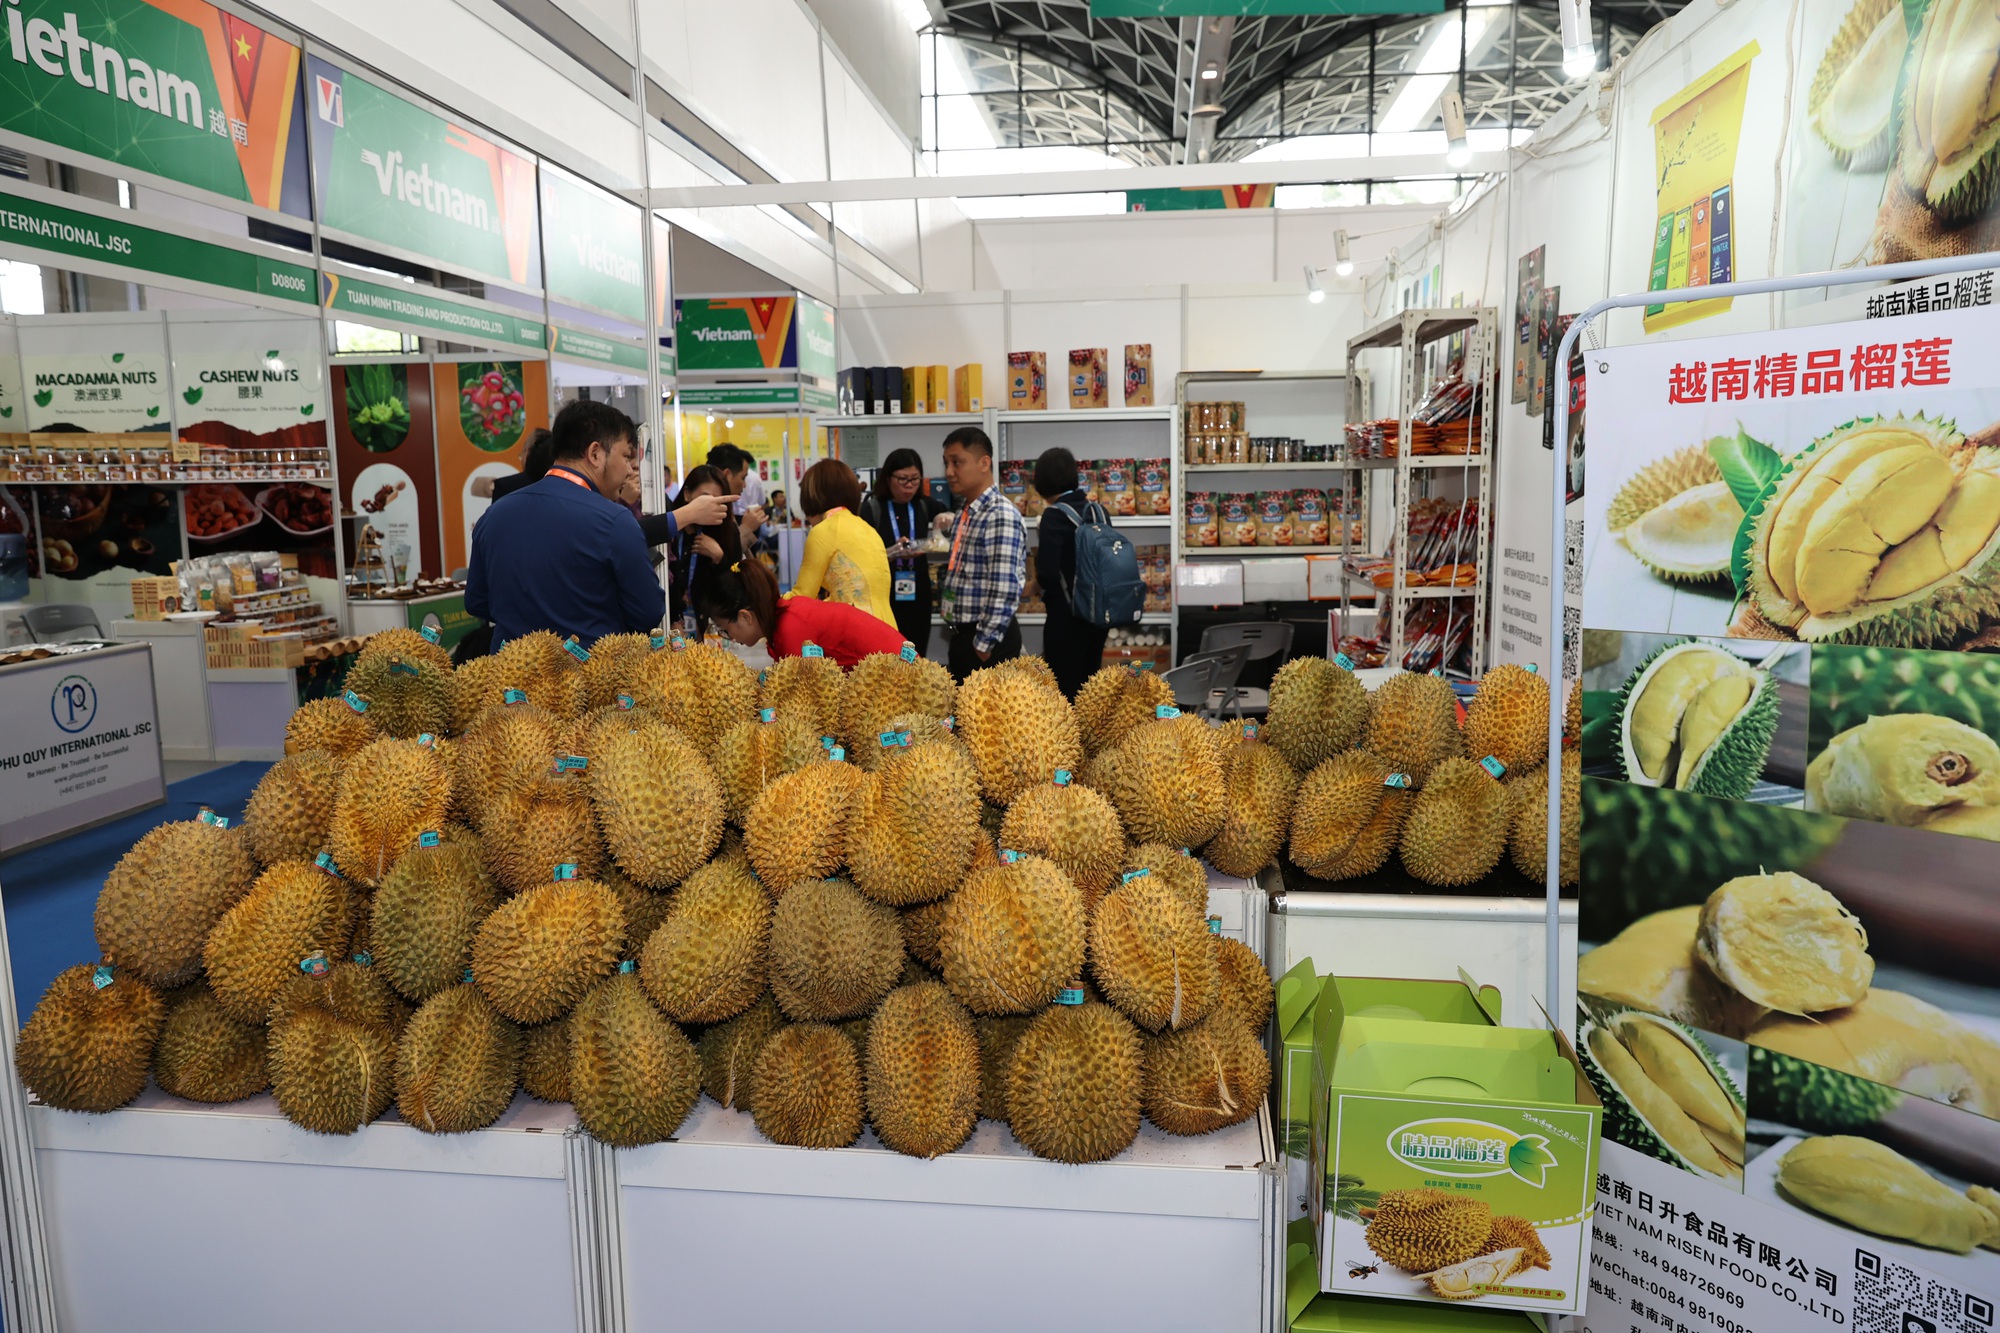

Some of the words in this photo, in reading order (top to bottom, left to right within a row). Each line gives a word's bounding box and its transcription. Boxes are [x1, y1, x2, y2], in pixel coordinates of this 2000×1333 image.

[0, 0, 205, 130] ietnam
[208, 107, 249, 148] 越南
[360, 148, 489, 231] Vietnam
[105, 234, 132, 255] JSC
[569, 232, 641, 287] Vietnam
[1711, 241, 1729, 255] WINTER
[271, 272, 306, 293] D08006
[1866, 270, 1995, 319] 越南精品榴莲
[347, 289, 371, 307] TUAN
[371, 294, 392, 311] MINH
[392, 299, 424, 318] TRADING
[425, 306, 440, 321] AND
[440, 310, 481, 330] PRODUCTION
[692, 326, 753, 342] Vietnam
[35, 372, 119, 386] MACADAMIA
[122, 371, 158, 384] NUTS
[199, 369, 259, 383] CASHEW
[262, 369, 299, 382] NUTS
[237, 385, 264, 399] 腰果
[1668, 337, 1953, 406] 越南精品榴莲
[73, 387, 124, 402] 澳洲坚果
[22, 748, 47, 765] QUY
[50, 727, 131, 757] INTERNATIONAL
[133, 721, 153, 736] JSC
[27, 771, 35, 779] Be
[61, 762, 69, 770] Be
[1401, 1133, 1507, 1164] 精品榴莲
[1596, 1173, 1837, 1297] 越南日升食品有限公司
[1591, 1252, 1685, 1309] WeChat:0084
[1594, 1200, 1623, 1222] VIET
[1627, 1214, 1663, 1242] NAM
[1667, 1233, 1715, 1266] RISEN
[1720, 1257, 1767, 1289] FOOD
[1772, 1282, 1845, 1325] CO.,LTD
[1633, 1247, 1658, 1268] +84
[1662, 1259, 1744, 1309] 948726969
[1630, 1298, 1700, 1333] 越南河内
